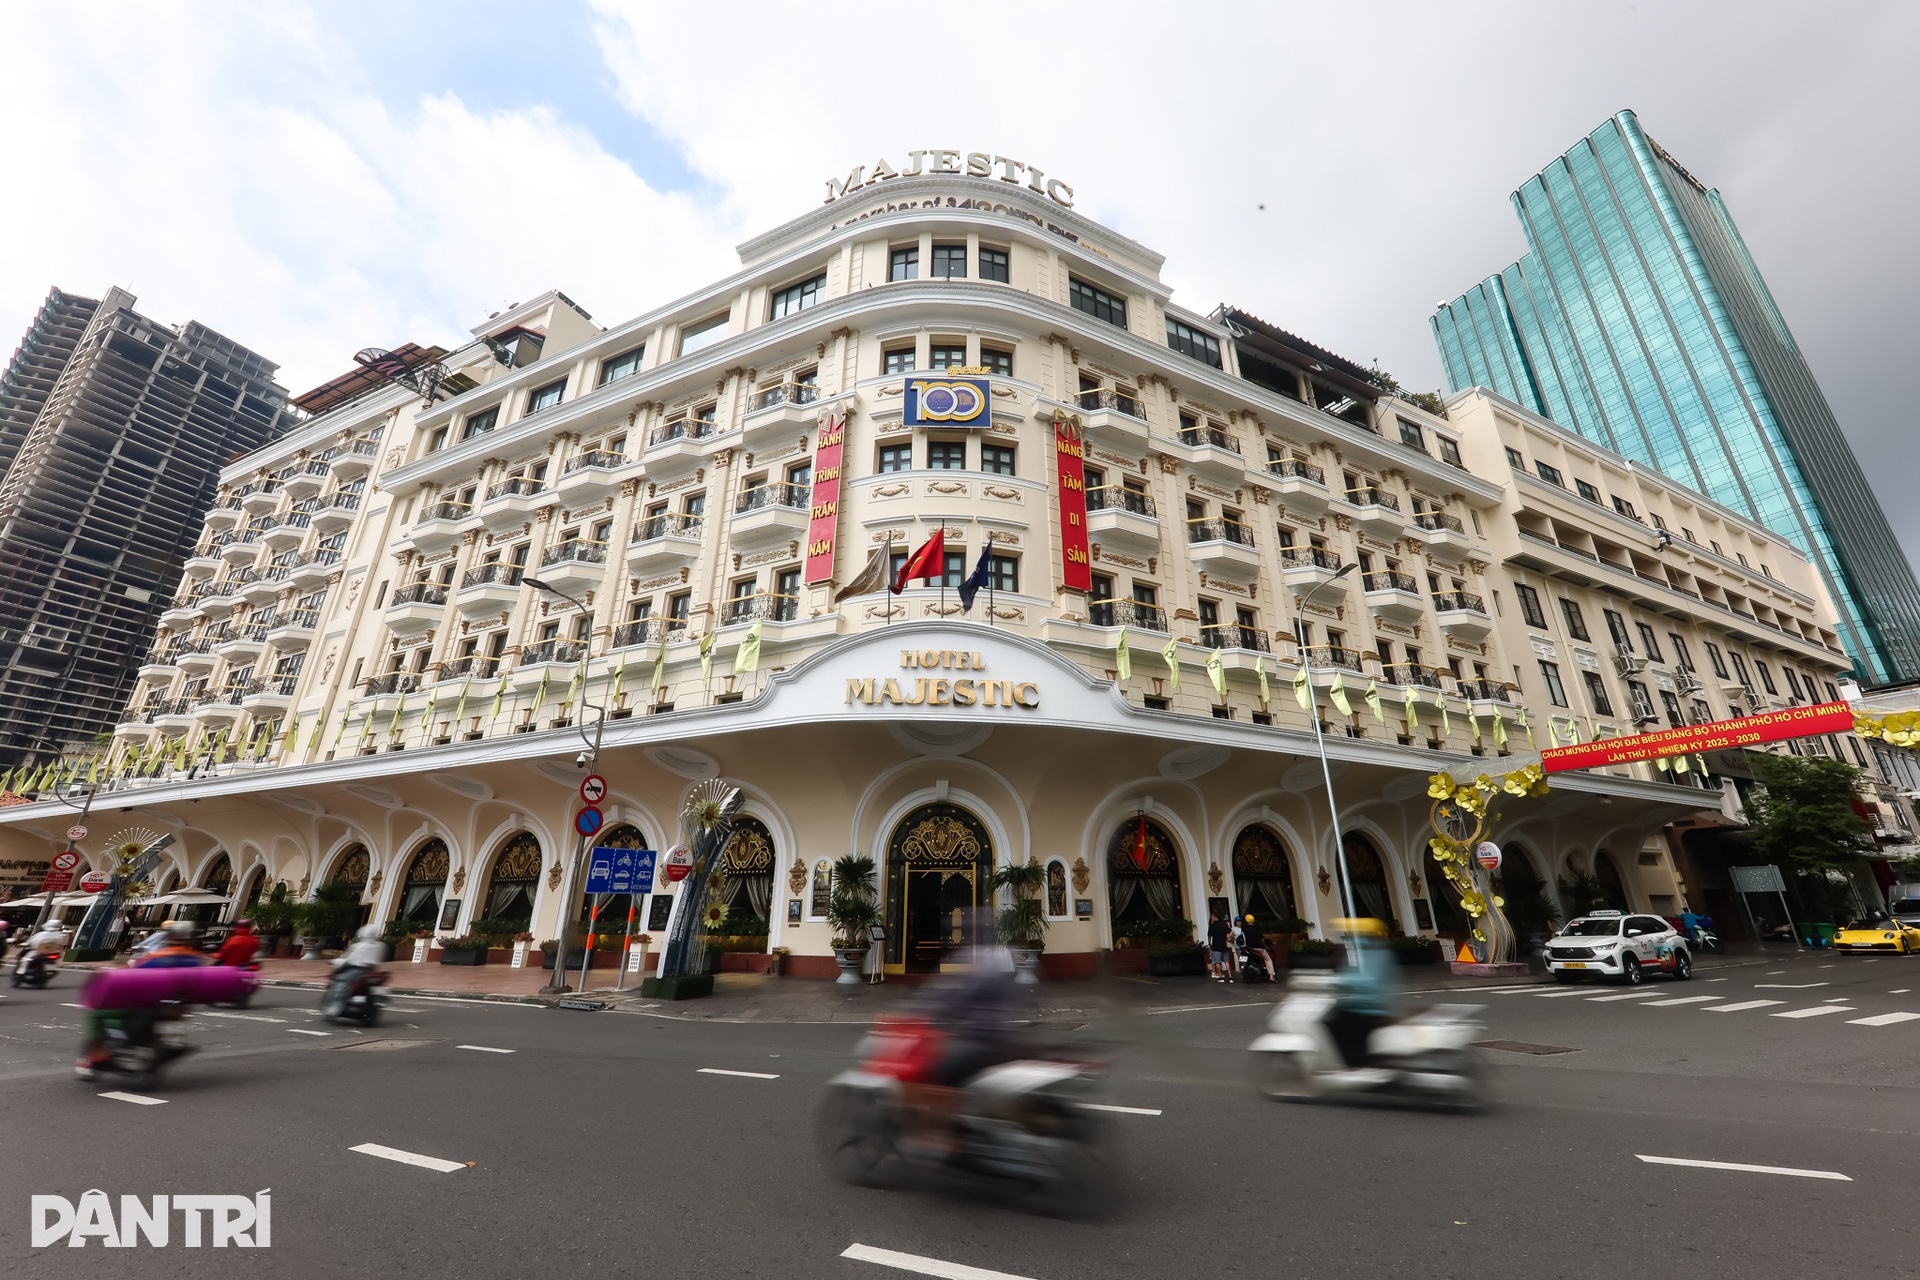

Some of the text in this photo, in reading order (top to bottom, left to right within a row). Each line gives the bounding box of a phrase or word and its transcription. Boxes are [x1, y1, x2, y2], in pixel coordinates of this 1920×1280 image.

[824, 149, 1073, 208] MAJESTIC
[910, 381, 986, 421] 100
[817, 432, 843, 449] HÀNH
[1057, 440, 1083, 458] NÂNG
[814, 466, 840, 484] TRÌNH
[1062, 471, 1083, 492] TẦM
[811, 501, 837, 520] TRĂM
[1069, 512, 1080, 526] DI
[809, 539, 831, 557] NĂM
[1067, 544, 1087, 564] SẢN
[899, 650, 988, 670] HOTEL
[843, 678, 1041, 710] MAJESTIC
[1542, 704, 1848, 759] CHÀO MỪNG ĐẠI HỘI ĐẠI BIỂU ĐẢNG BỘ THÀNH PHỐ HỒ CHÍ MINH
[1607, 753, 1626, 762] LẦN
[1626, 748, 1646, 759] THỨ
[1657, 743, 1688, 754] NHIỆM
[1690, 739, 1703, 750] KỲ
[1706, 737, 1729, 748] 2025
[1736, 732, 1760, 743] 2030
